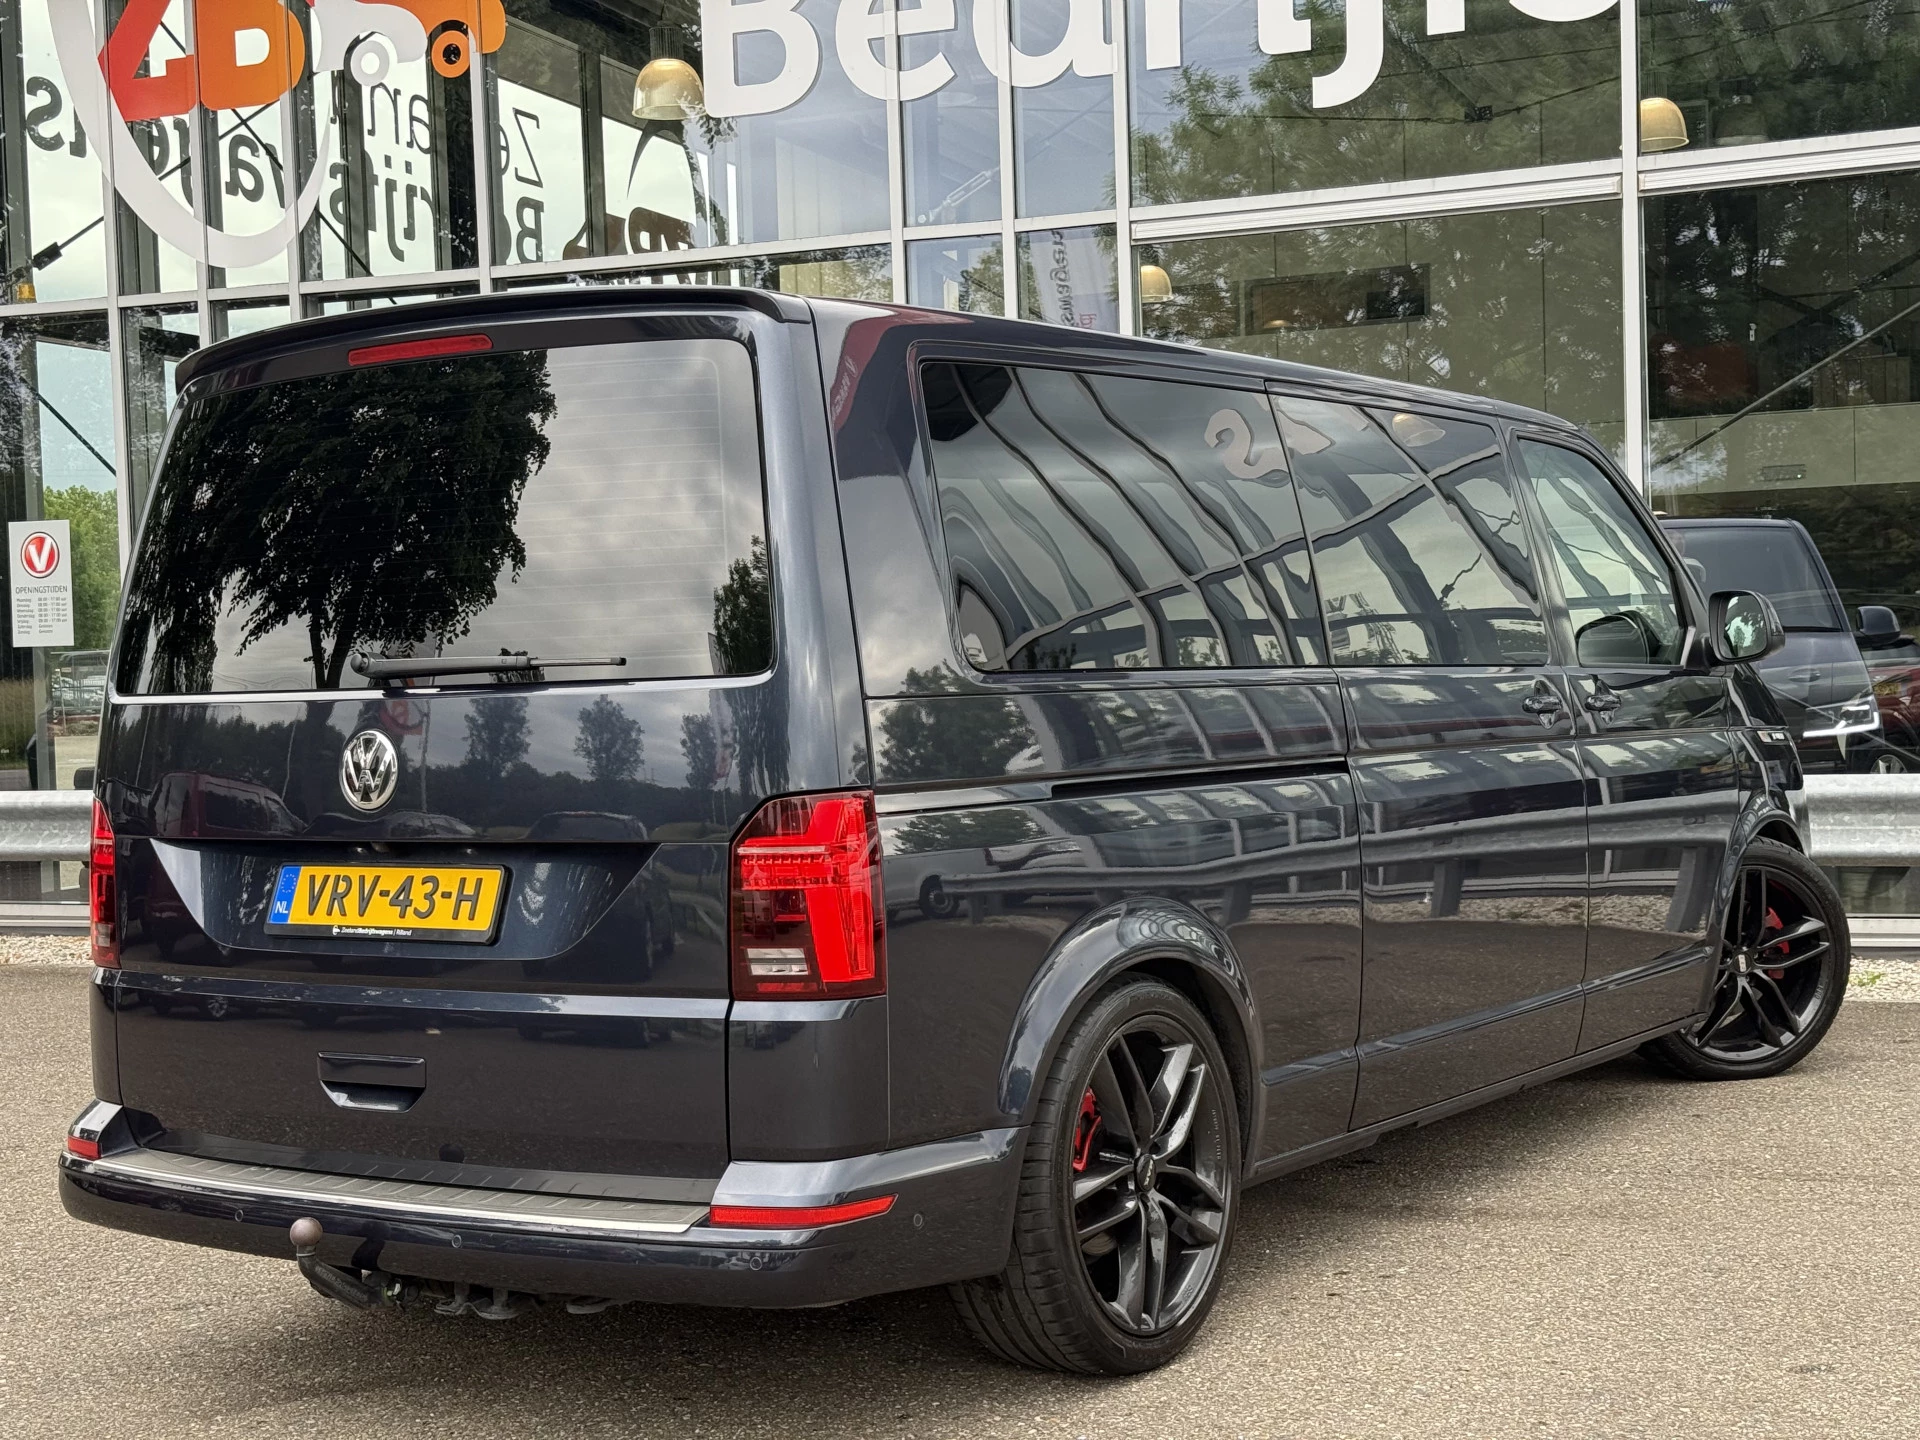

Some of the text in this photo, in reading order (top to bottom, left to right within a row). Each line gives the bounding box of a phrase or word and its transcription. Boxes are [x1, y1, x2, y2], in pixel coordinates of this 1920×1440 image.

[15, 585, 68, 595] OPENINGSTIJDEN
[308, 874, 483, 921] VRV-43-H
[275, 901, 289, 914] NL
